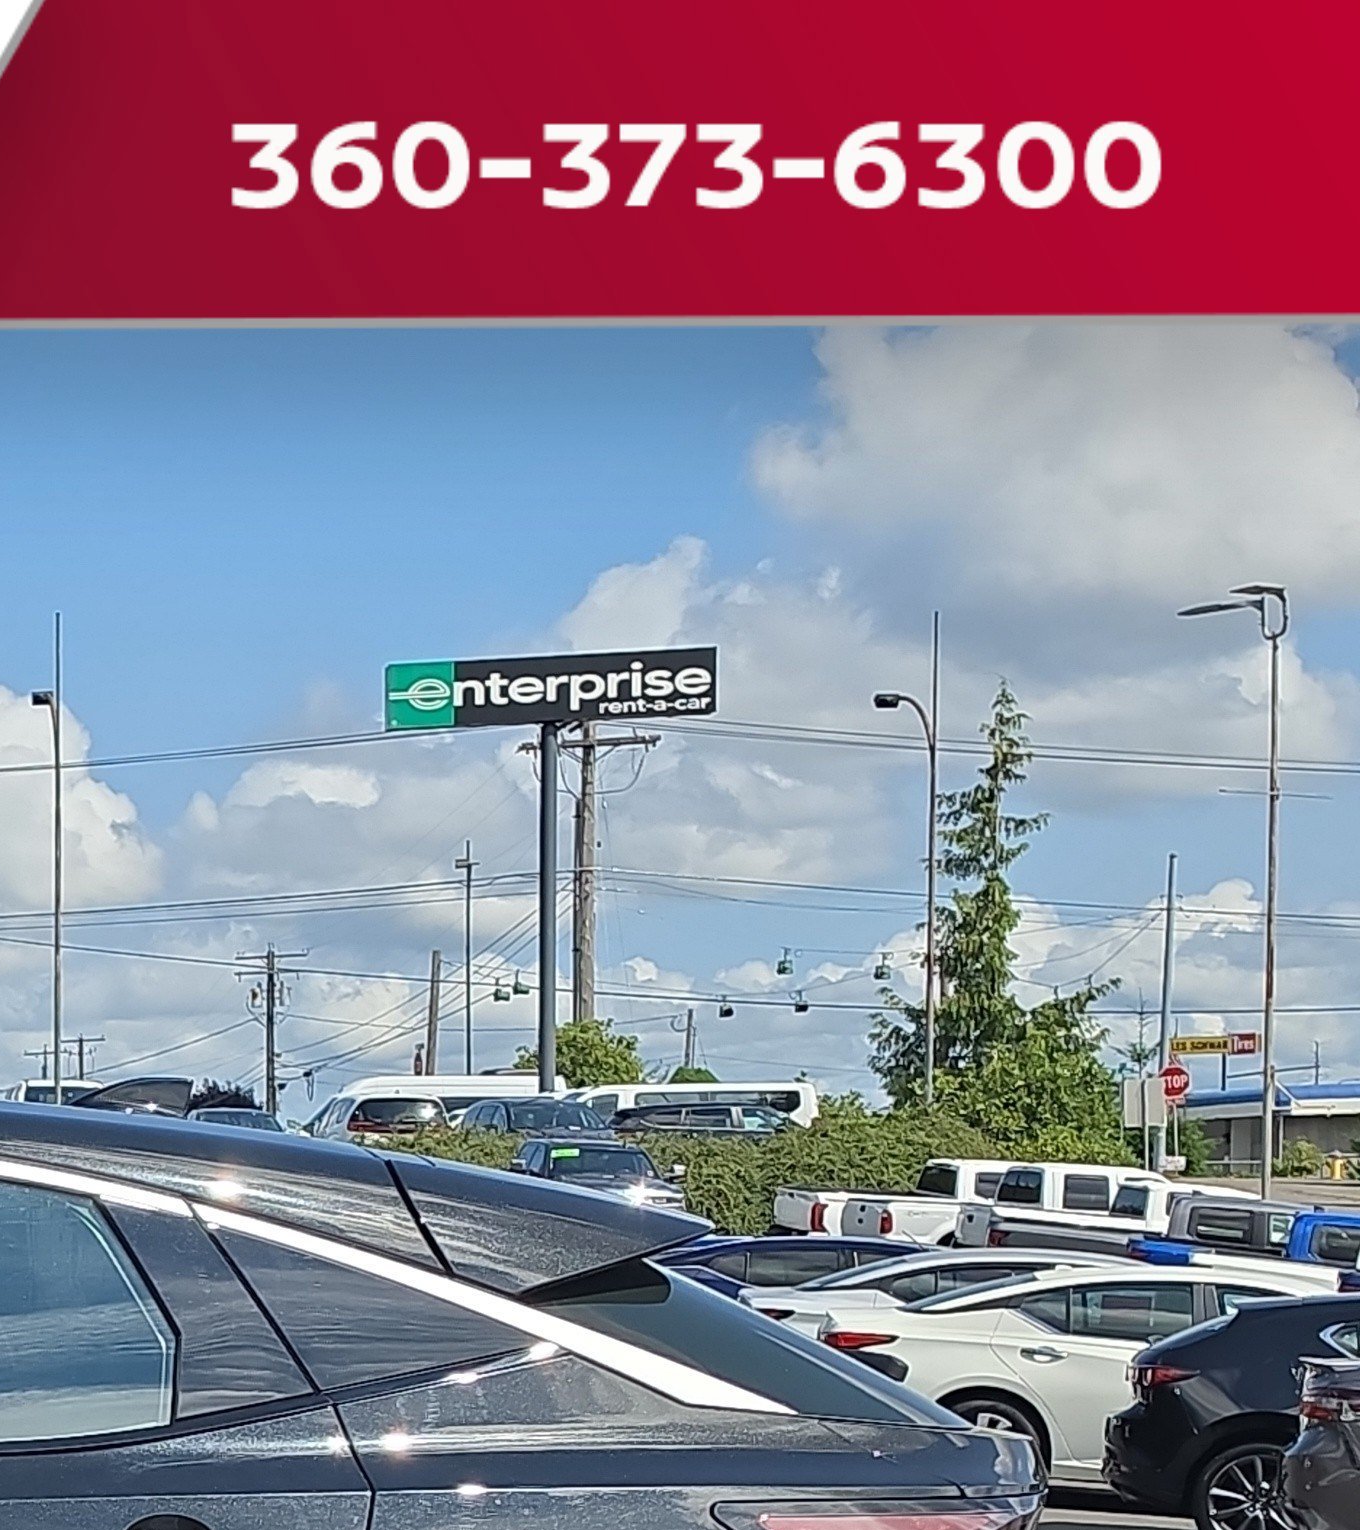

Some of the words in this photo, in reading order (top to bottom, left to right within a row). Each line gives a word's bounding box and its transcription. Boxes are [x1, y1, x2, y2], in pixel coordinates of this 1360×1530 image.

[388, 662, 712, 711] enterprise
[599, 697, 712, 715] rent-a-car
[1164, 1074, 1188, 1090] TOP
